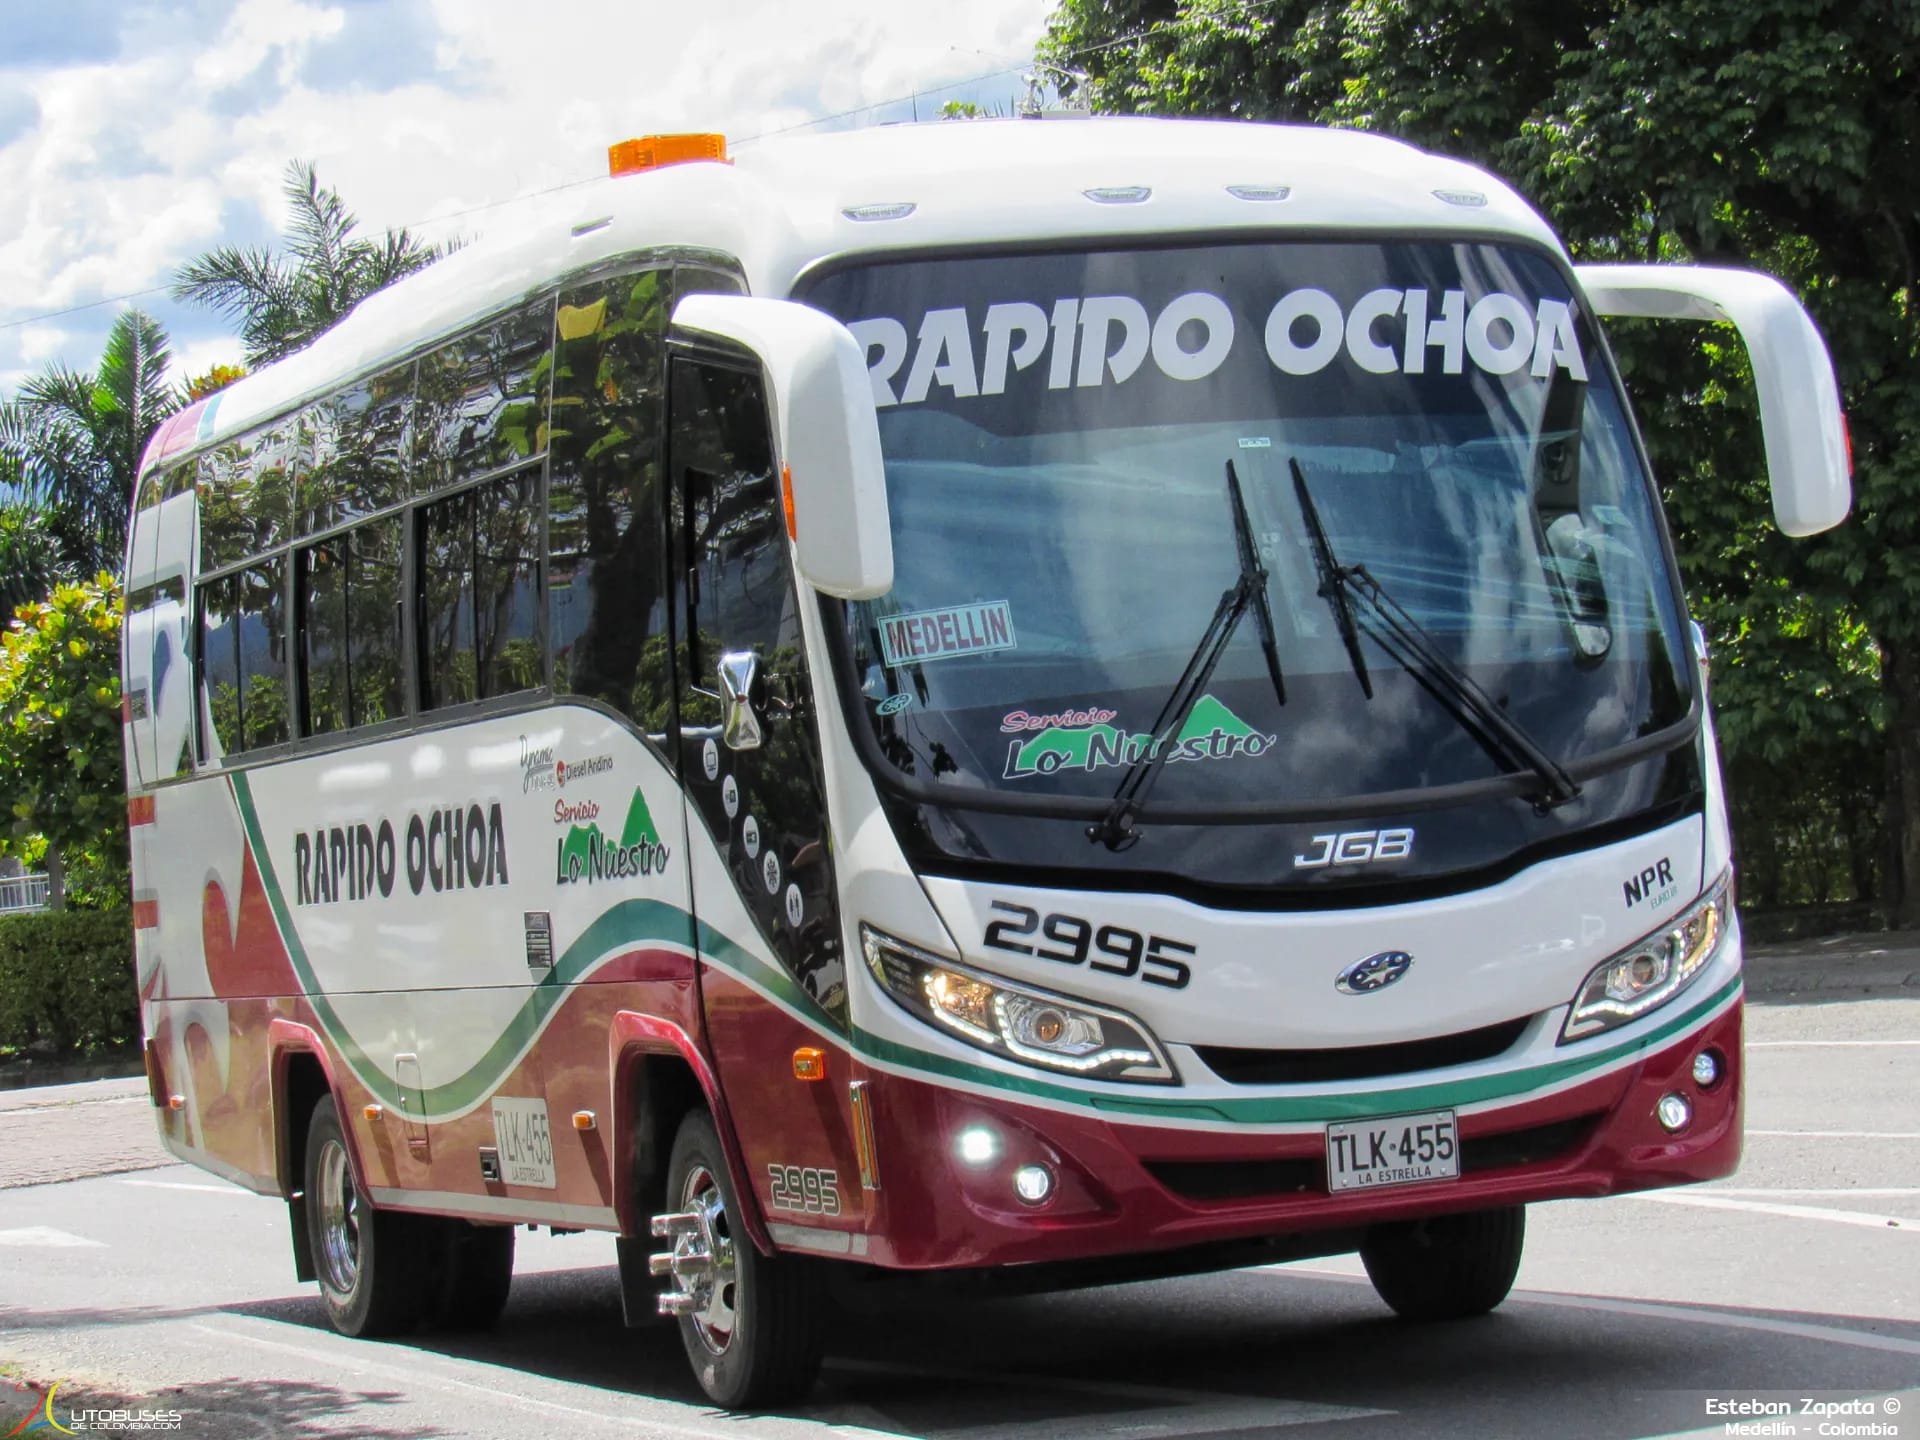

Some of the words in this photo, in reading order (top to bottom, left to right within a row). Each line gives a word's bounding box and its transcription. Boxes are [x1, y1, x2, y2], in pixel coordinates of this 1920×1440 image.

[846, 291, 1235, 409] RAPIDO
[1264, 287, 1589, 382] OCHOA
[884, 606, 1009, 660] MEDELLIN
[1000, 708, 1118, 734] Servicio
[566, 759, 587, 780] Diesel
[587, 755, 614, 777] Andino
[1003, 738, 1071, 779] Lo
[1084, 726, 1277, 773] Nuestro
[554, 798, 600, 823] Servicio
[295, 818, 396, 906] RAPIDO
[406, 802, 510, 896] OCHOA
[556, 837, 583, 885] Lo
[588, 831, 671, 885] Nuestro
[1293, 827, 1416, 869] JGB
[1623, 857, 1674, 908] NPR
[983, 899, 1197, 991] 2995
[768, 1163, 841, 1216] 2995
[1358, 1173, 1373, 1185] LA
[1378, 1165, 1432, 1182] ESTRELLA
